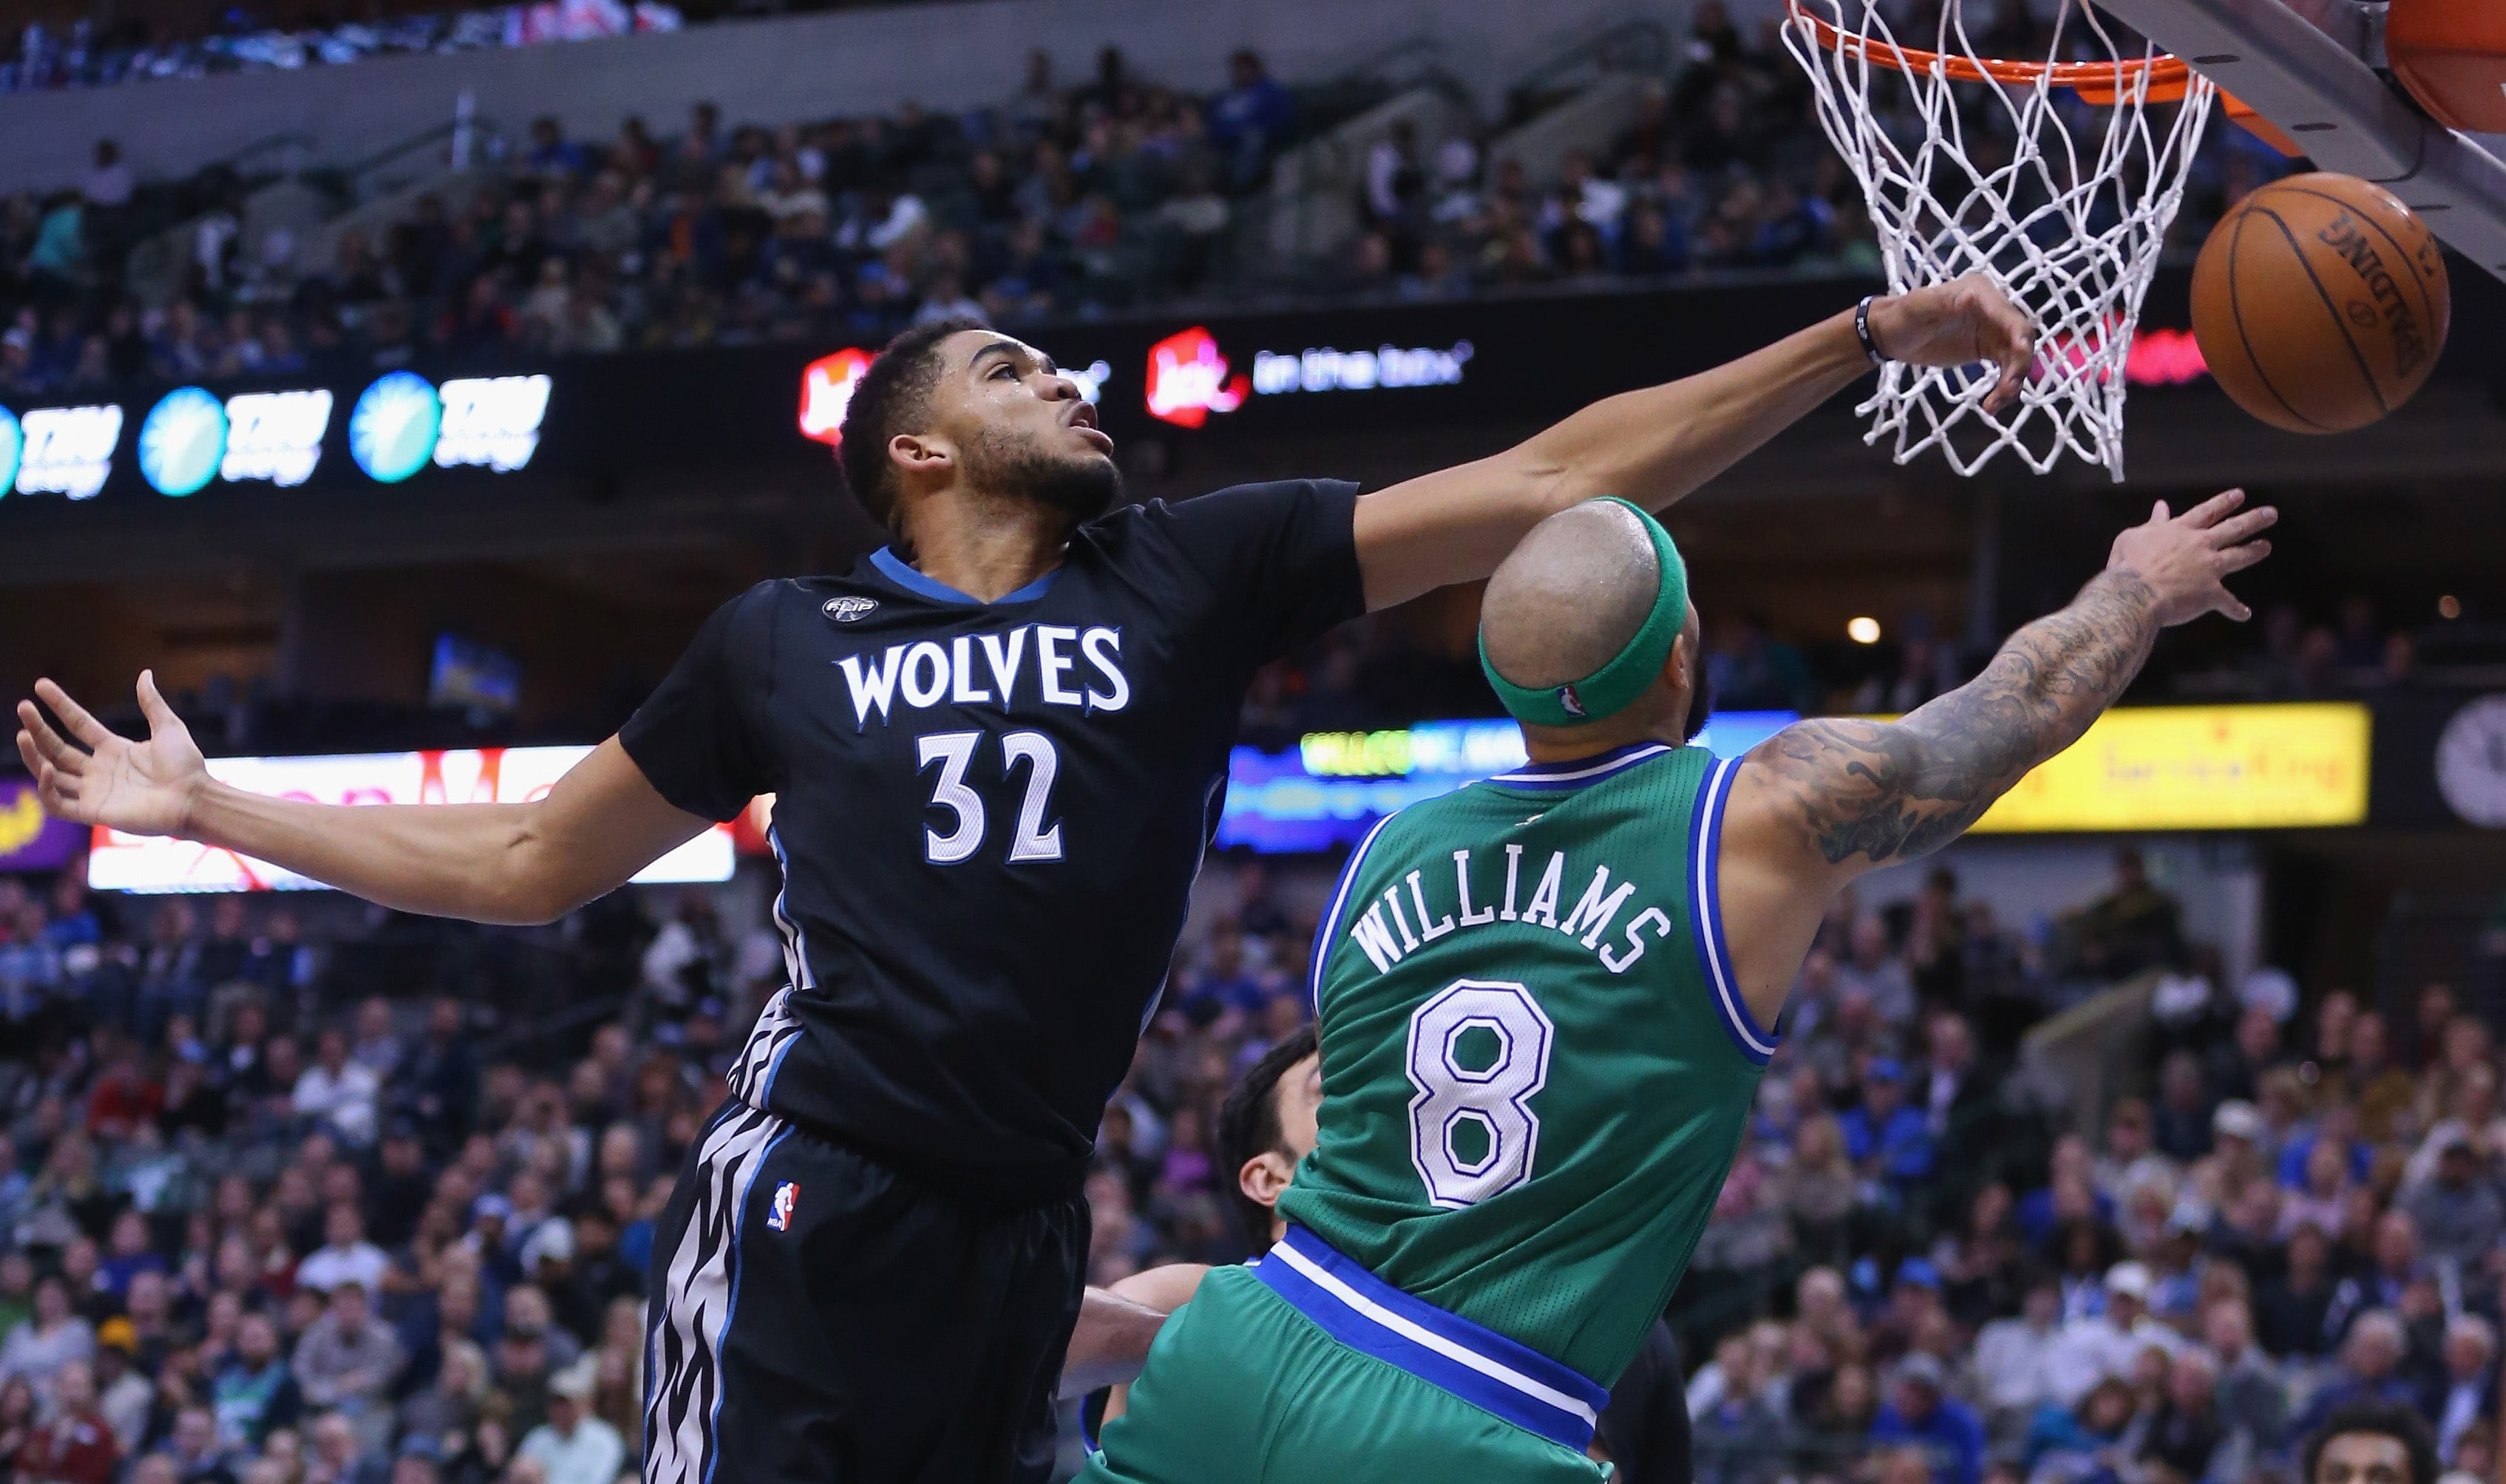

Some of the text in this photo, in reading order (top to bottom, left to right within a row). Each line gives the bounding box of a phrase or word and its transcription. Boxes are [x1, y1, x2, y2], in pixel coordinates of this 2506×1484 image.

[2318, 211, 2428, 379] SPALDING
[832, 623, 1130, 733] WOLVES
[914, 729, 1066, 867] 32
[1350, 844, 1671, 974] WILLIAMS
[1405, 978, 1555, 1211] 8
